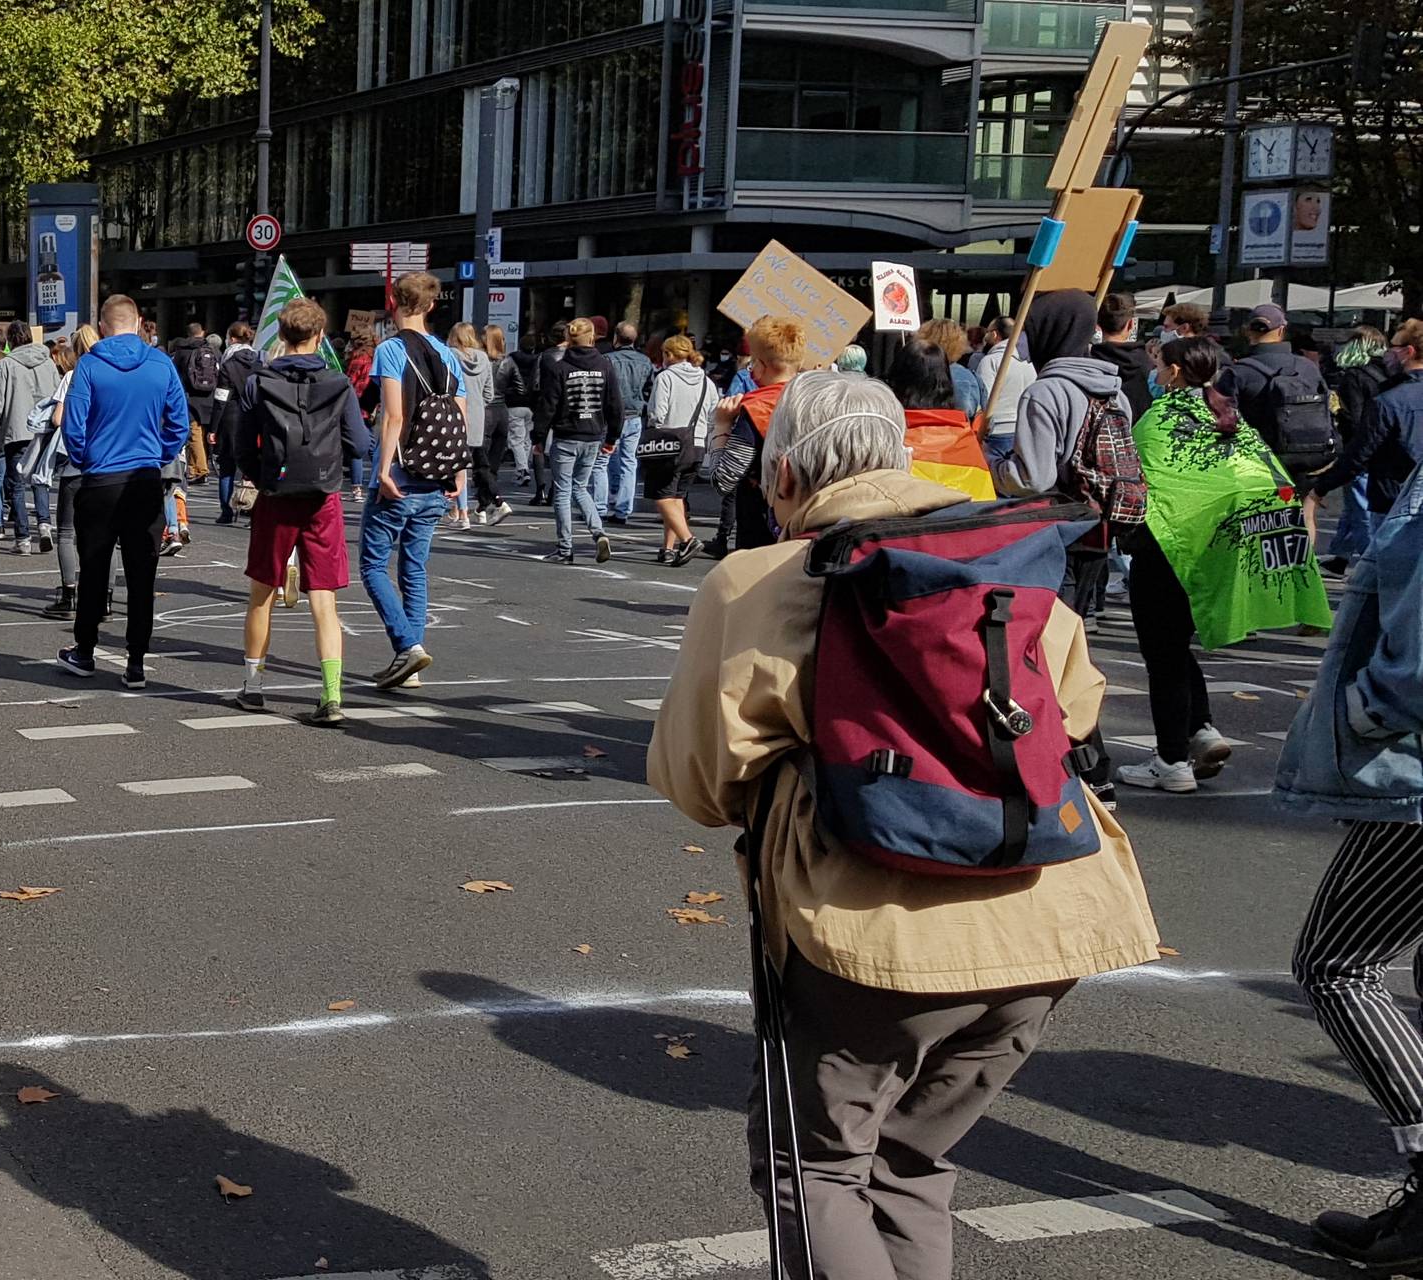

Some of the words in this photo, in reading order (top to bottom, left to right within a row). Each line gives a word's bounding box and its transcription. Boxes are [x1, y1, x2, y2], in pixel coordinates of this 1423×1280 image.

[254, 225, 273, 240] 30
[462, 263, 473, 278] U
[490, 266, 522, 277] senplatz
[488, 292, 505, 303] TTO
[637, 440, 680, 454] adidas
